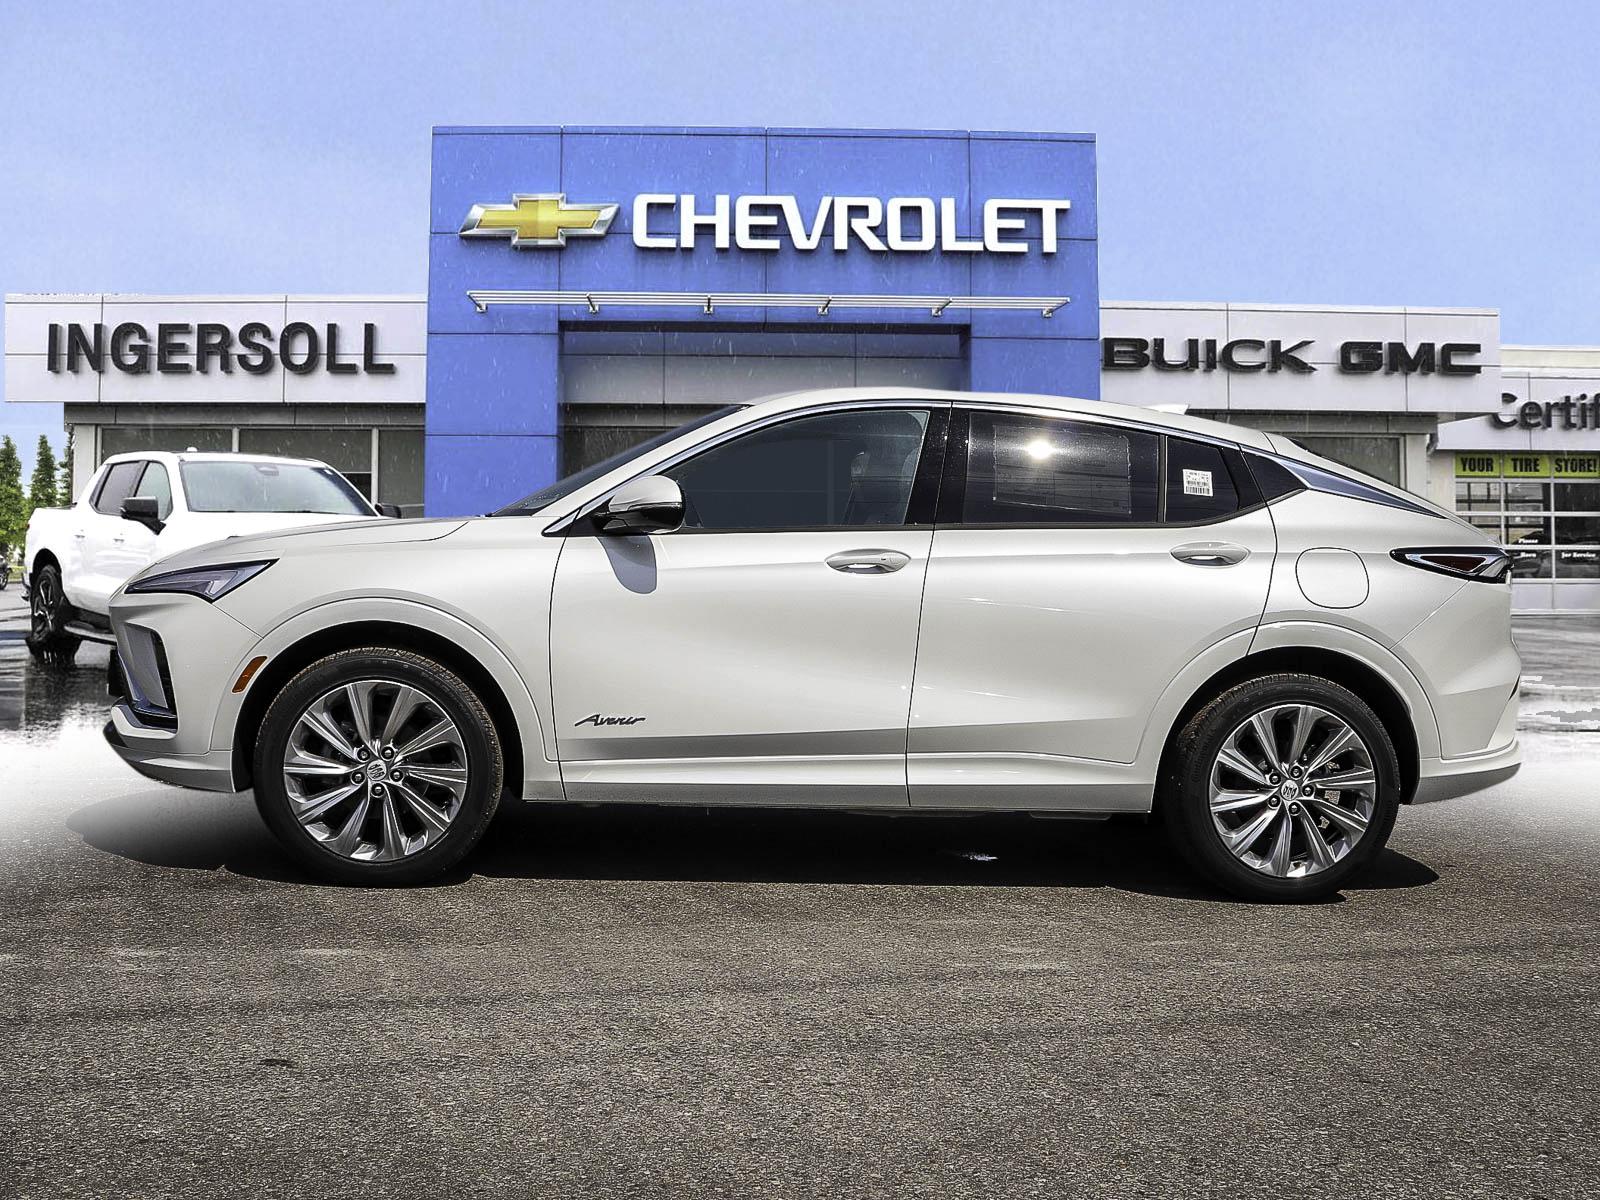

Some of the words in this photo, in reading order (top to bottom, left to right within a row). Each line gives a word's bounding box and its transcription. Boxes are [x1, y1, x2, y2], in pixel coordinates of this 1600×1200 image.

[632, 193, 1071, 255] CHEVROLET
[47, 322, 395, 375] INGERSOLL
[1102, 336, 1317, 374] BUICK
[1340, 341, 1482, 375] GMC
[1460, 457, 1494, 473] YOUR
[1511, 457, 1540, 473] TIRE
[1554, 457, 1598, 473] STORE!
[574, 713, 646, 727] Avenir
